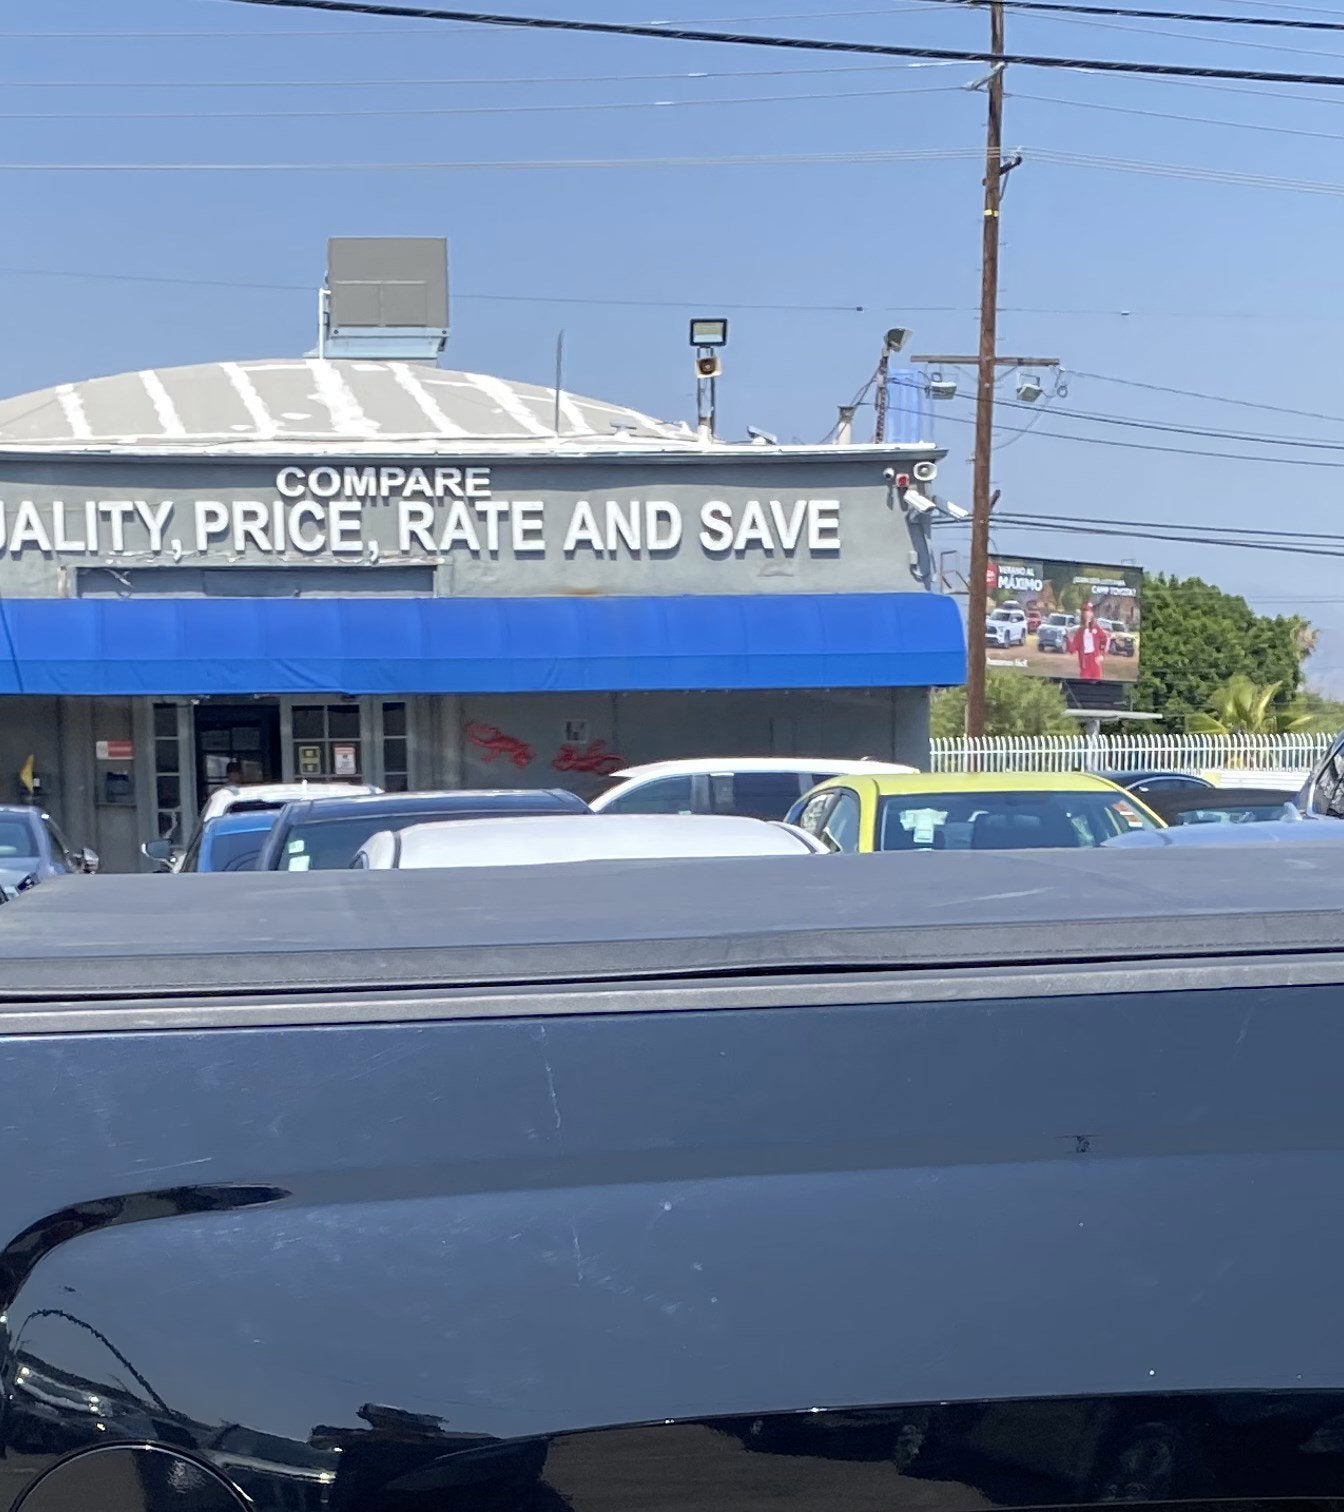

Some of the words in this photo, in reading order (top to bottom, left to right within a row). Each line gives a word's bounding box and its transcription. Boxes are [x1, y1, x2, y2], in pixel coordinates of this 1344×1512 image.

[275, 466, 492, 498] COMPARE
[194, 500, 379, 562] PRICE,
[398, 500, 546, 551] RATE
[563, 500, 683, 551] AND
[699, 499, 841, 551] SAVE
